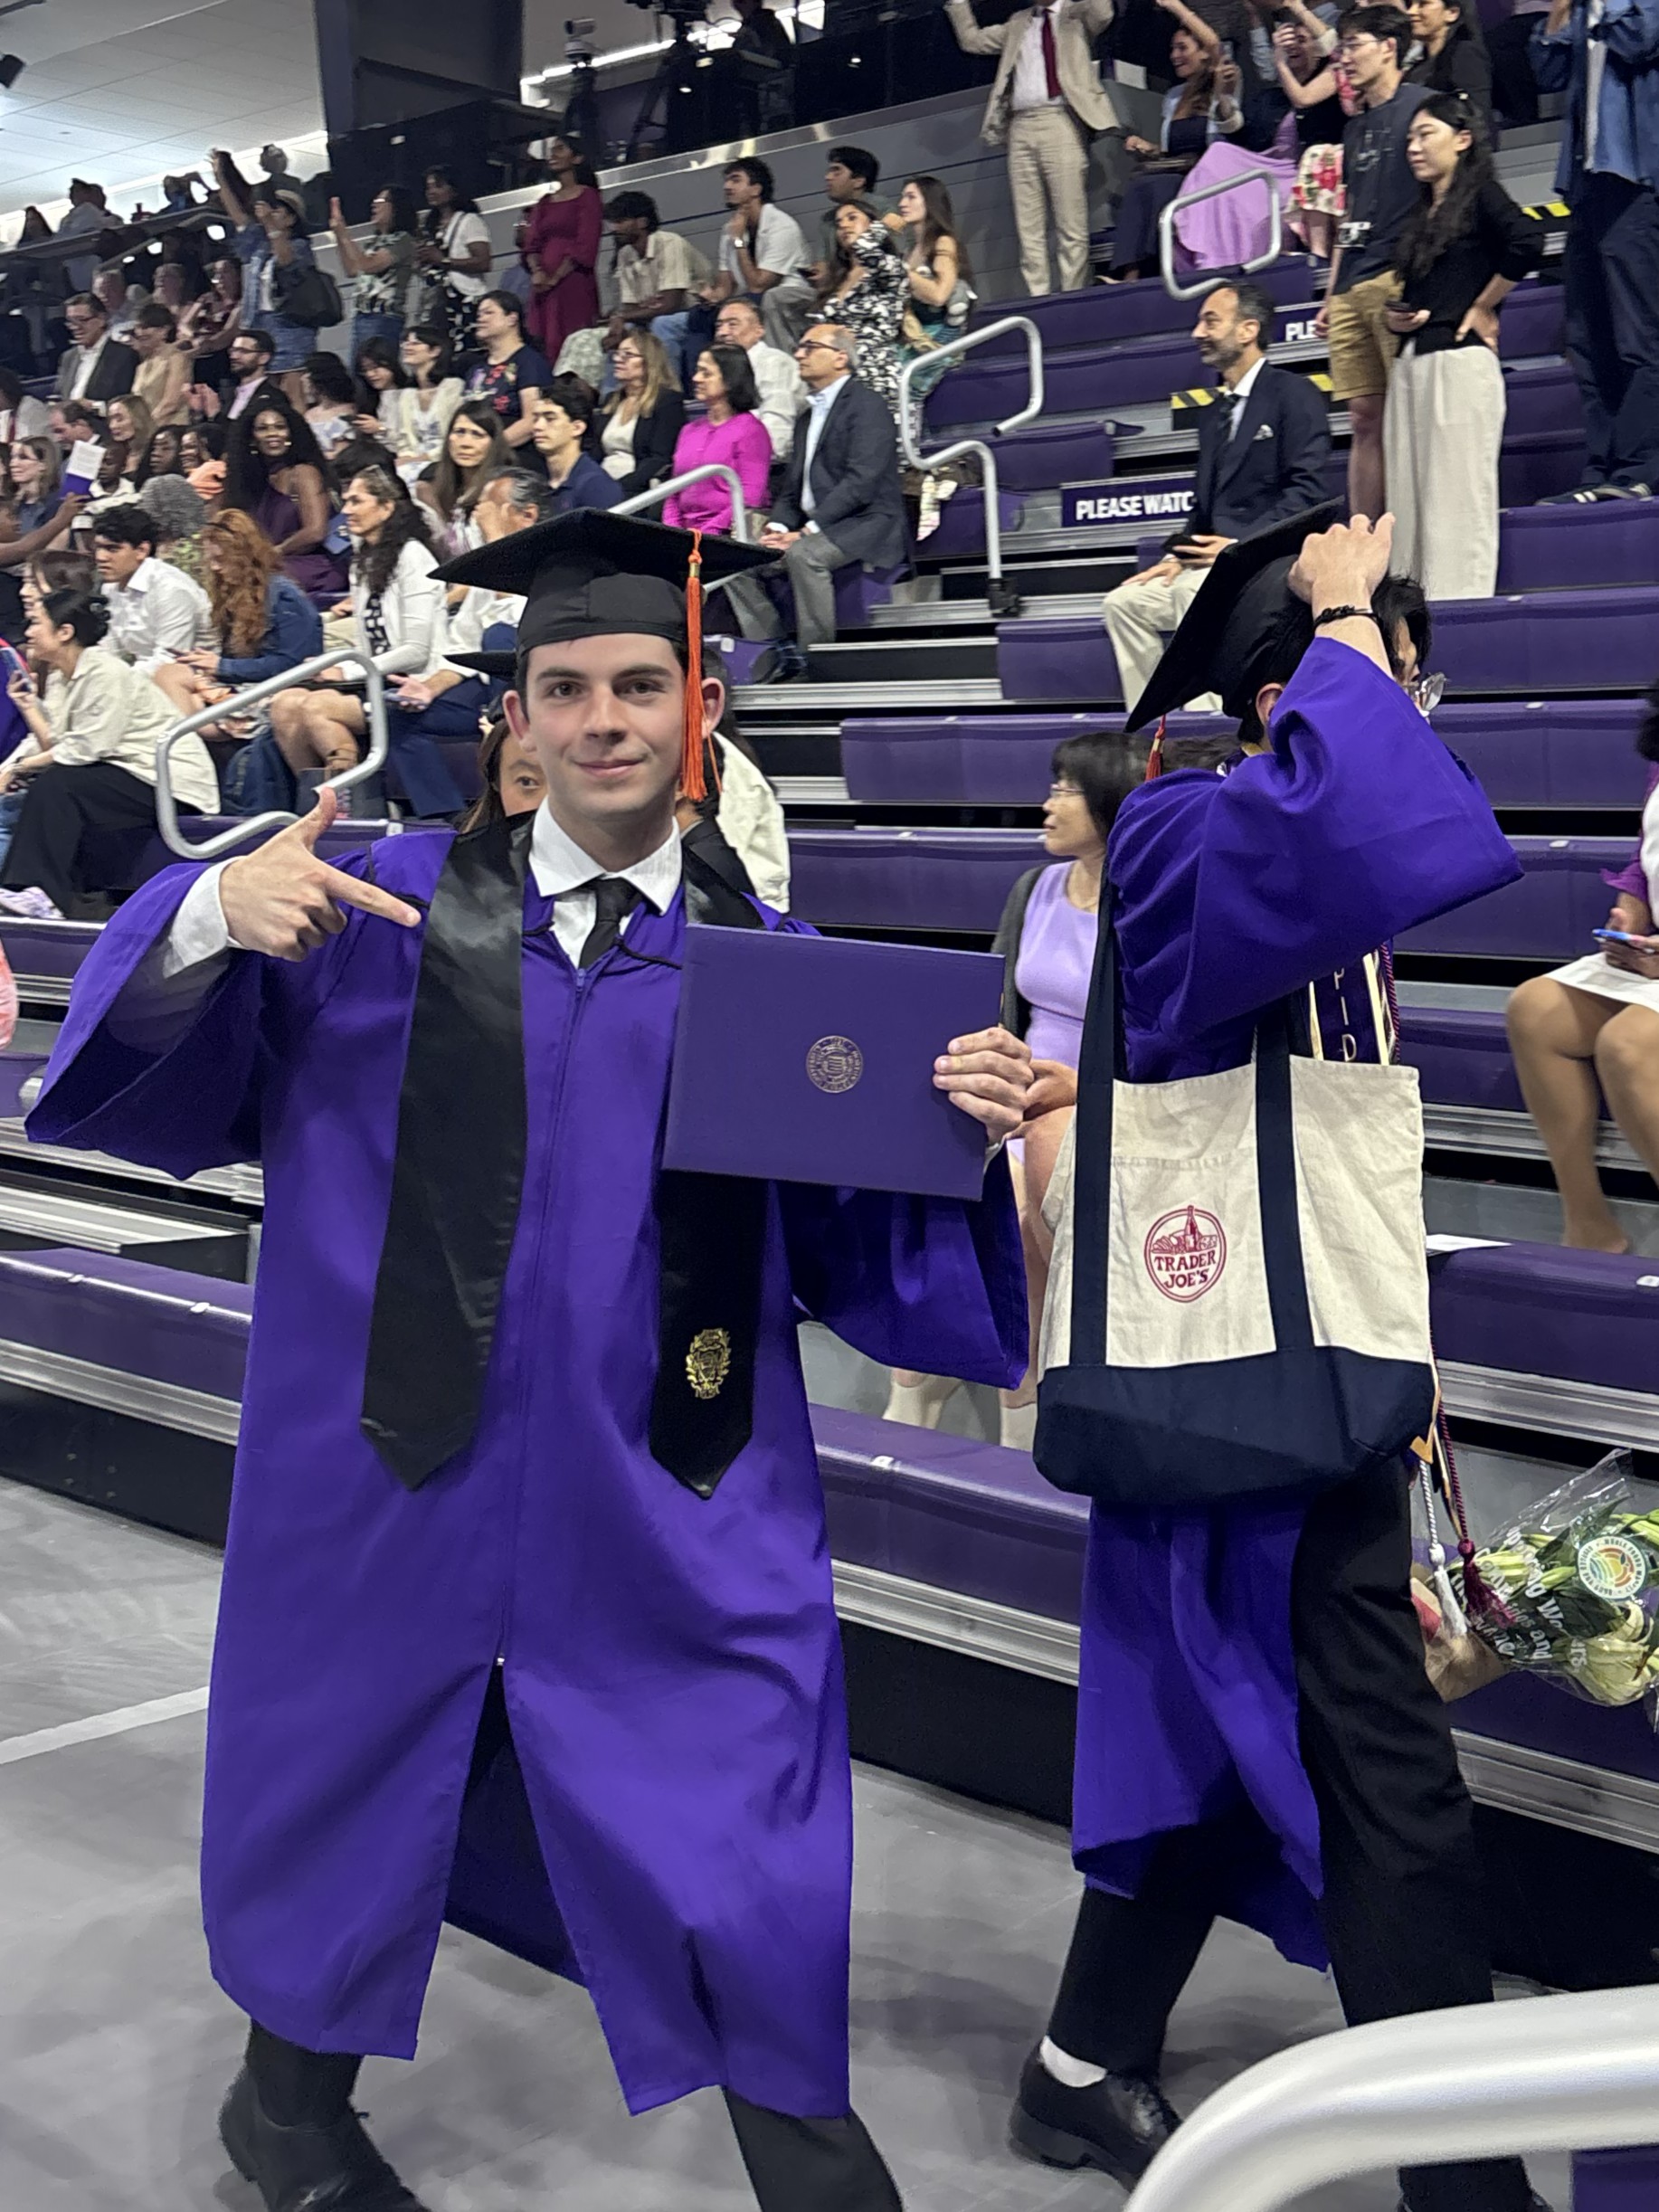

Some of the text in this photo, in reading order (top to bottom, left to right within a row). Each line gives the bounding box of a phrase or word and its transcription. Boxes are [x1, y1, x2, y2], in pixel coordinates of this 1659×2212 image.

[1285, 318, 1318, 341] PLE
[1076, 491, 1195, 520] PLEASE WATC
[1154, 1249, 1216, 1272] TRADER
[1163, 1268, 1209, 1288] JOE'S
